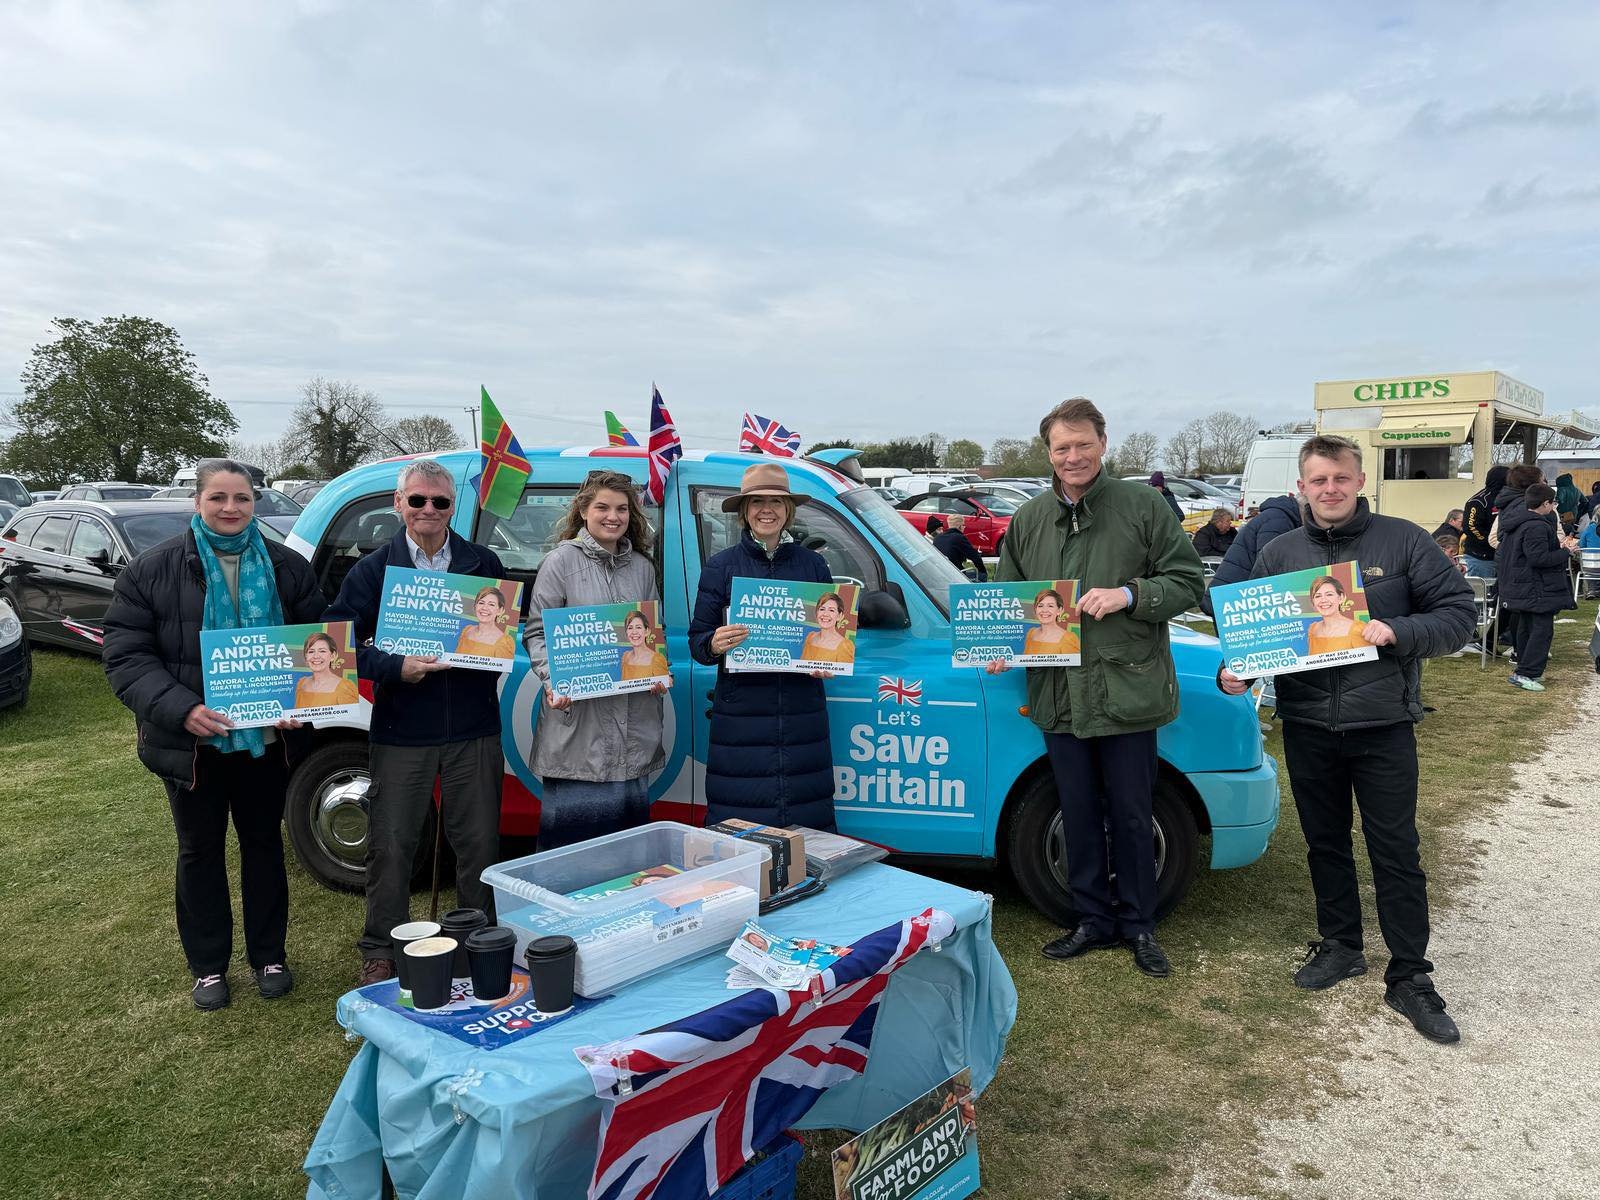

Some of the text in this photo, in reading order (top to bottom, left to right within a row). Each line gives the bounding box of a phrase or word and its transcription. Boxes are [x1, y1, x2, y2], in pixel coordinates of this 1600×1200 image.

[1353, 379, 1451, 401] CHIPS
[1381, 430, 1452, 441] Cappuccino
[413, 576, 445, 587] VOTE
[391, 583, 463, 602] ANDREA
[759, 586, 788, 596] VOTE
[974, 589, 1003, 597] VOTE
[1239, 584, 1273, 598] VOTE
[387, 595, 464, 615] JENKYNS
[740, 594, 805, 609] ANDREA
[957, 598, 1022, 609] ANDREA
[1221, 590, 1297, 614] ANDREA
[385, 612, 460, 625] MAYORAL CANDIDATE
[568, 612, 596, 623] VOTE
[736, 607, 807, 622] JENKYNS
[955, 609, 1025, 621] JENKYNS
[1221, 603, 1303, 628] JENKYNS
[553, 621, 614, 637] ANDREA
[1225, 621, 1303, 638] MAYORAL CANDIDATE
[232, 634, 267, 645] VOTE
[398, 639, 444, 651] ANDREA
[552, 632, 618, 650] JENKYNS
[1226, 634, 1255, 643] GREATER
[210, 643, 290, 661] ANDREA
[406, 648, 443, 659] MAYOR
[554, 649, 618, 661] MAYORAL CANDIDATE
[749, 648, 790, 658] ANDREA
[1247, 649, 1296, 664] ANDREA
[208, 656, 294, 675] JENKYNS
[756, 657, 790, 666] MAYOR
[1258, 658, 1298, 671] MAYOR
[210, 674, 293, 686] MAYORAL CANDIDATE
[572, 674, 611, 686] ANDREA
[581, 682, 613, 693] MAYOR
[231, 702, 281, 714] ANDREA
[242, 710, 282, 721] MAYOR
[877, 709, 921, 726] Let's
[849, 724, 949, 766] Save
[833, 766, 965, 808] Britain
[860, 1118, 957, 1200] FARMLAND
[894, 1143, 949, 1197] FOOD
